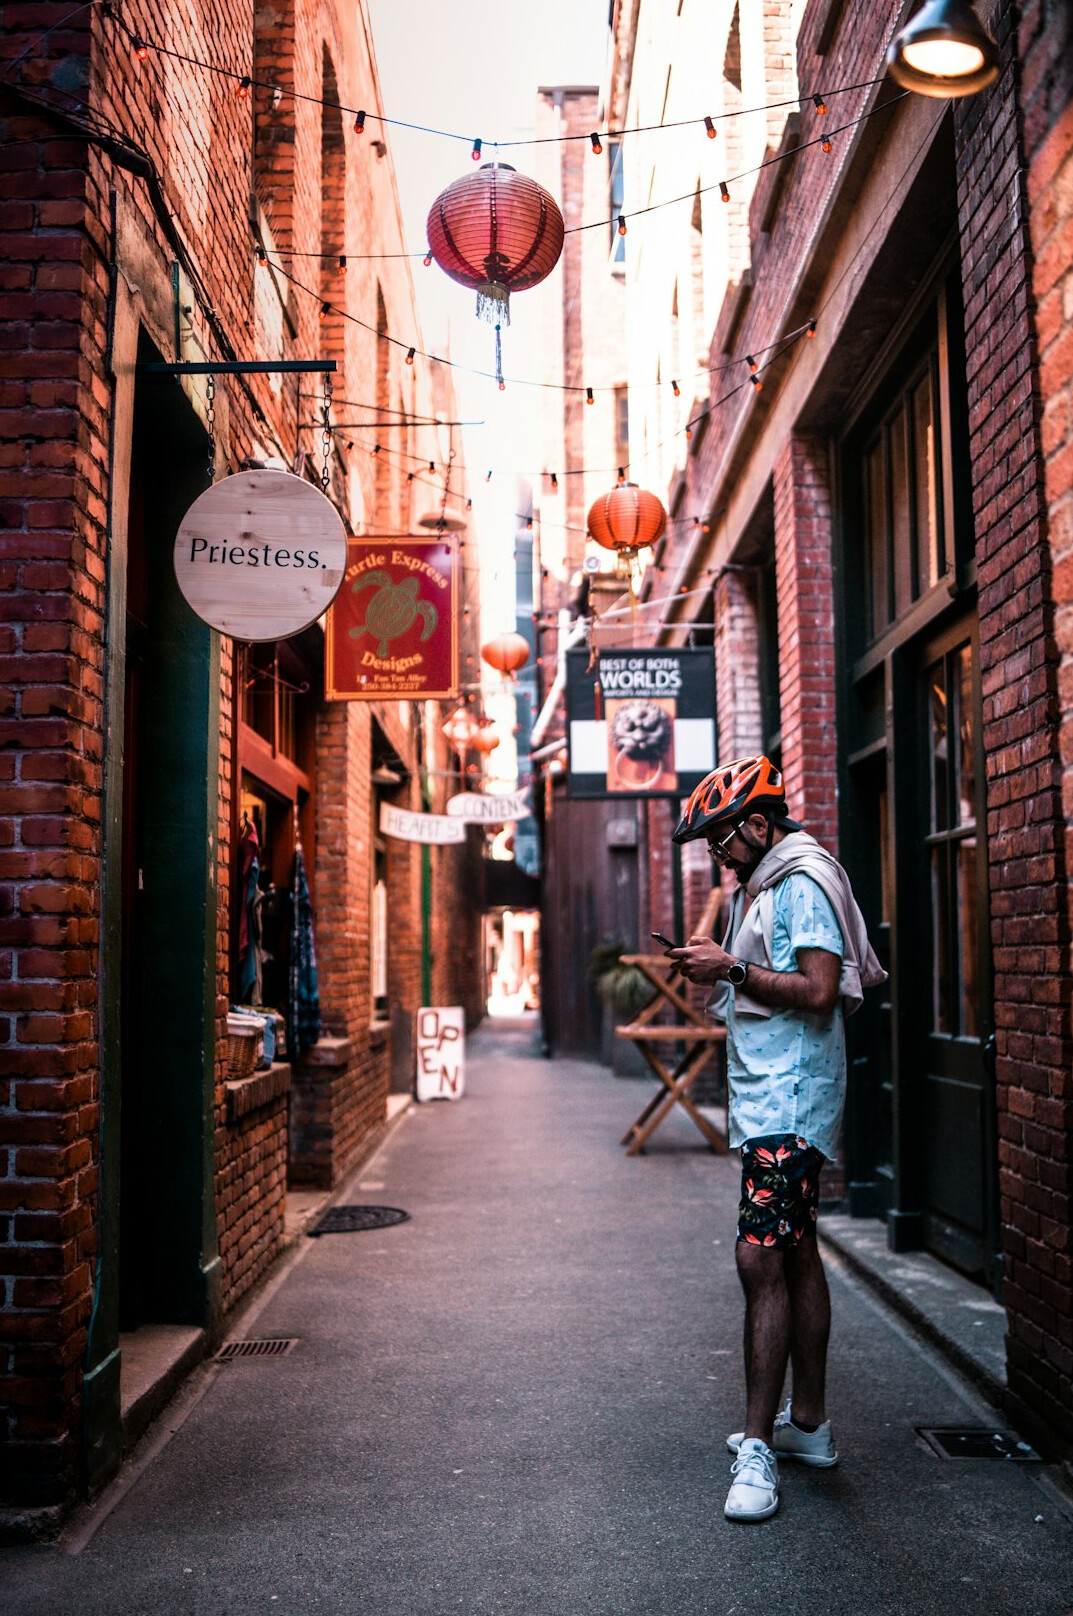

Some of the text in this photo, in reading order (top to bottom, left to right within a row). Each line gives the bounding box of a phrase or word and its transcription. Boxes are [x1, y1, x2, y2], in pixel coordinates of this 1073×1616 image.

[189, 537, 327, 569] Priestess.
[344, 549, 449, 589] urtle Express
[360, 650, 423, 673] Designs
[600, 657, 680, 671] BEST OF BOTH
[407, 673, 428, 684] Alley
[599, 669, 683, 689] WORLDS
[634, 689, 651, 697] AND
[420, 1011, 460, 1093] OPEN
